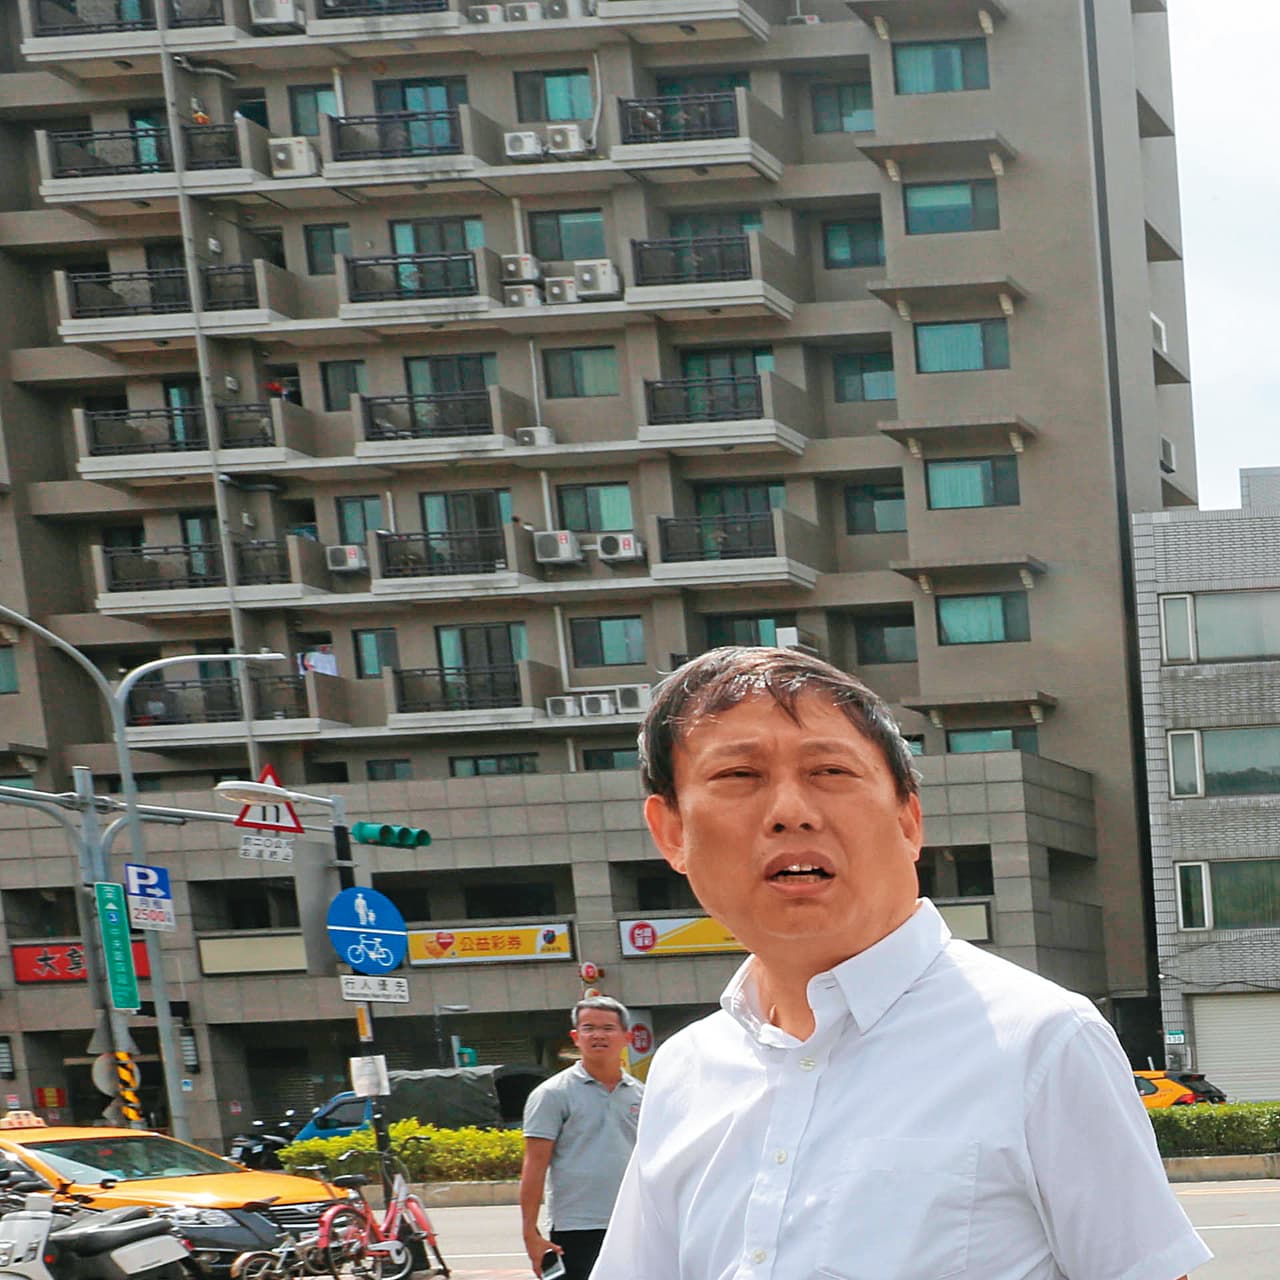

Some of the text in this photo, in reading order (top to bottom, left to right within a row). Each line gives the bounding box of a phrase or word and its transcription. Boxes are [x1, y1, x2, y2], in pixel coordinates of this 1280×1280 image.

[127, 866, 158, 894] P
[459, 935, 521, 951] 公益彩券
[344, 978, 406, 993] 行人優先
